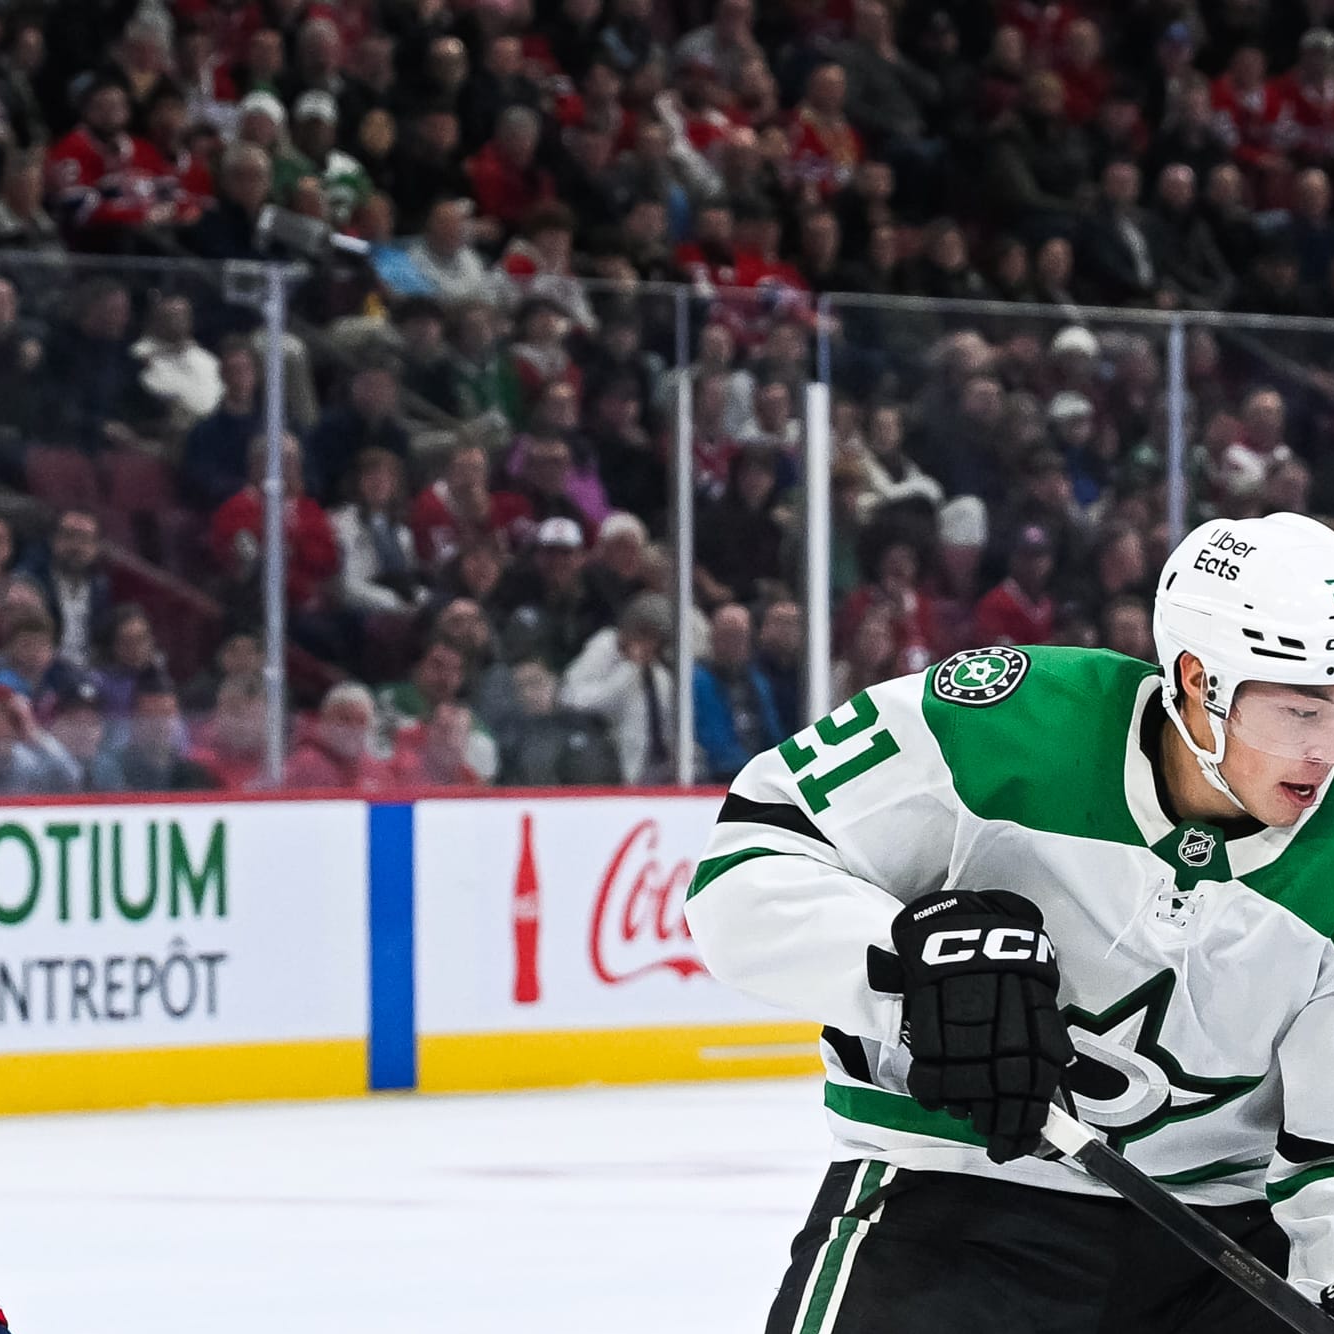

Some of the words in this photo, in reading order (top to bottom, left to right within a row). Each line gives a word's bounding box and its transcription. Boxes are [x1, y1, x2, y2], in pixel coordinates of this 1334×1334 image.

[1208, 528, 1257, 559] Uber
[1193, 549, 1240, 581] Eats
[777, 688, 902, 815] 21
[913, 897, 958, 921] ROBERTSON
